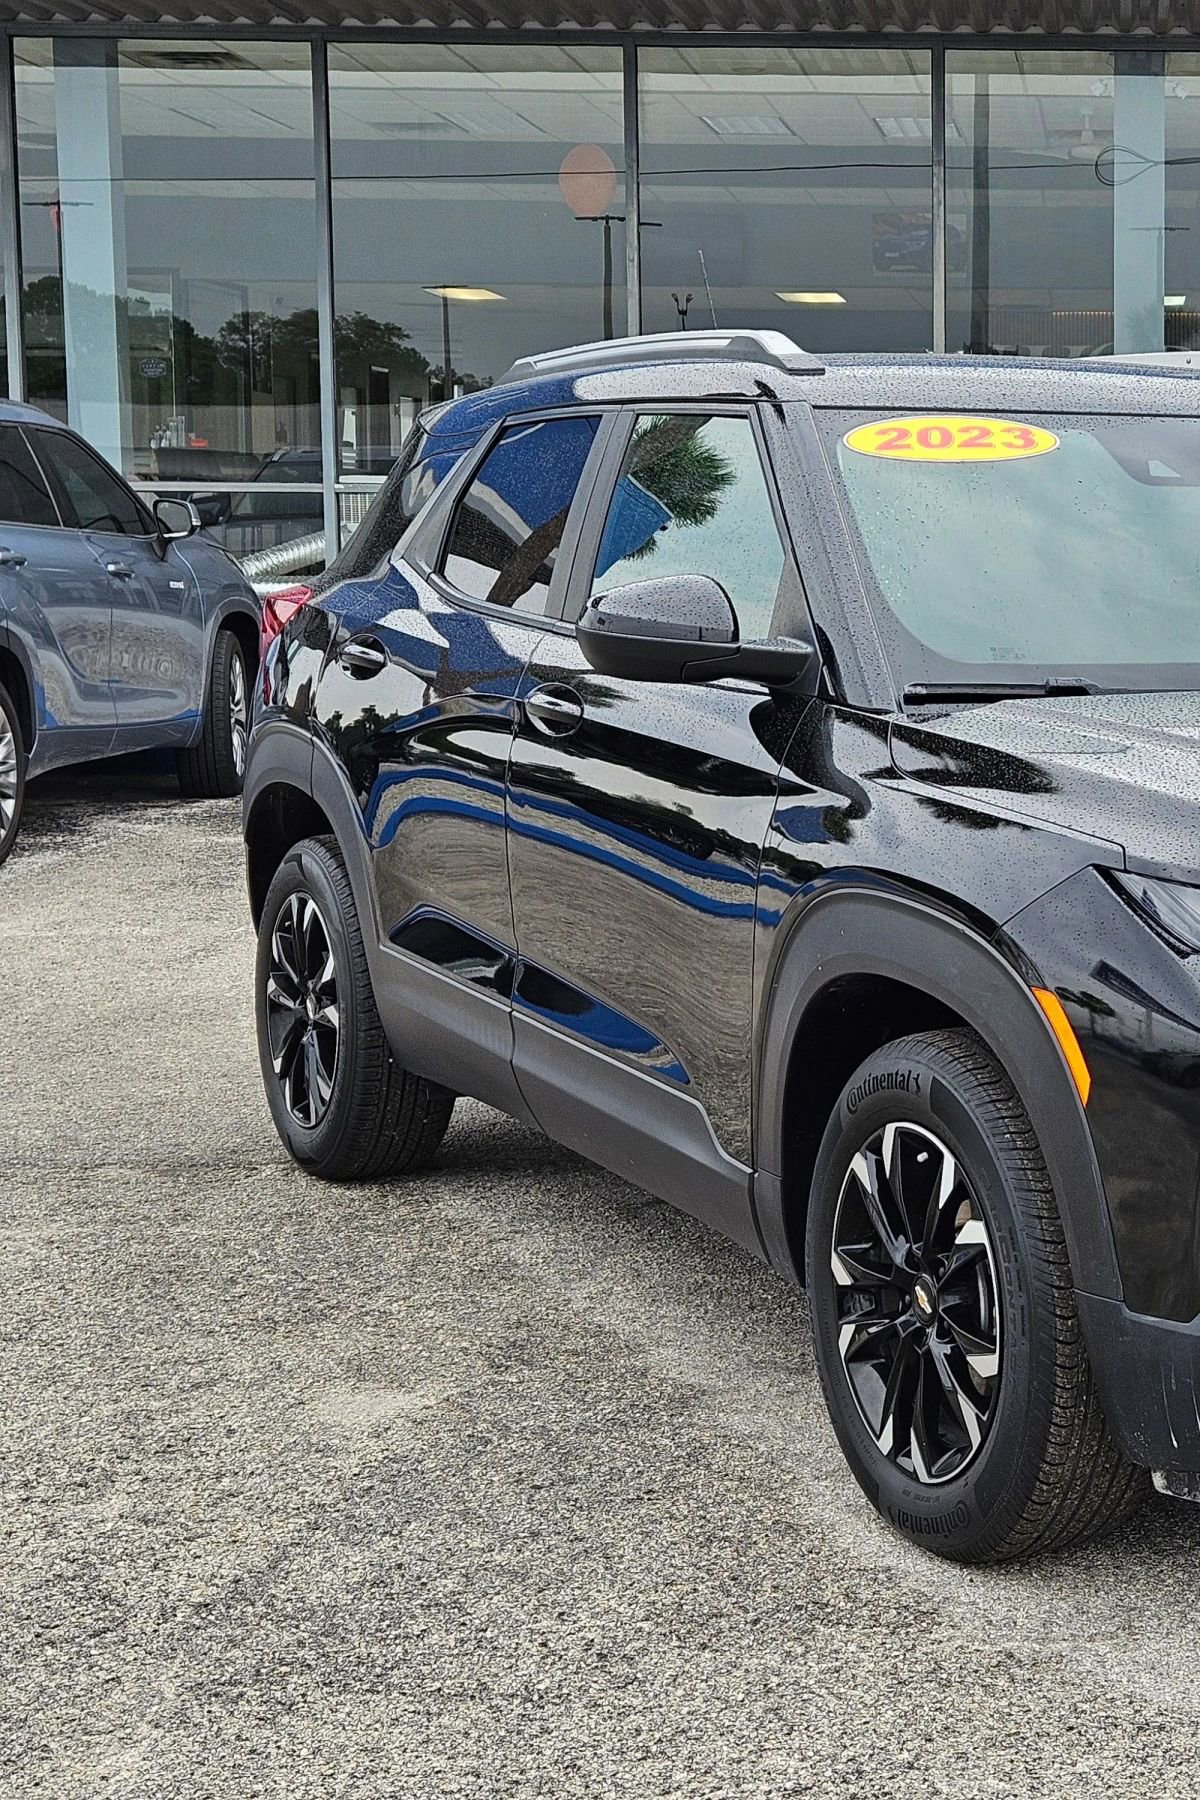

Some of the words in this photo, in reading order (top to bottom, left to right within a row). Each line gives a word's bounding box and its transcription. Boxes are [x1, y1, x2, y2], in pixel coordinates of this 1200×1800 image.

[874, 425, 1038, 451] 2023
[846, 1069, 912, 1115] Continental
[897, 1500, 970, 1539] Continental
